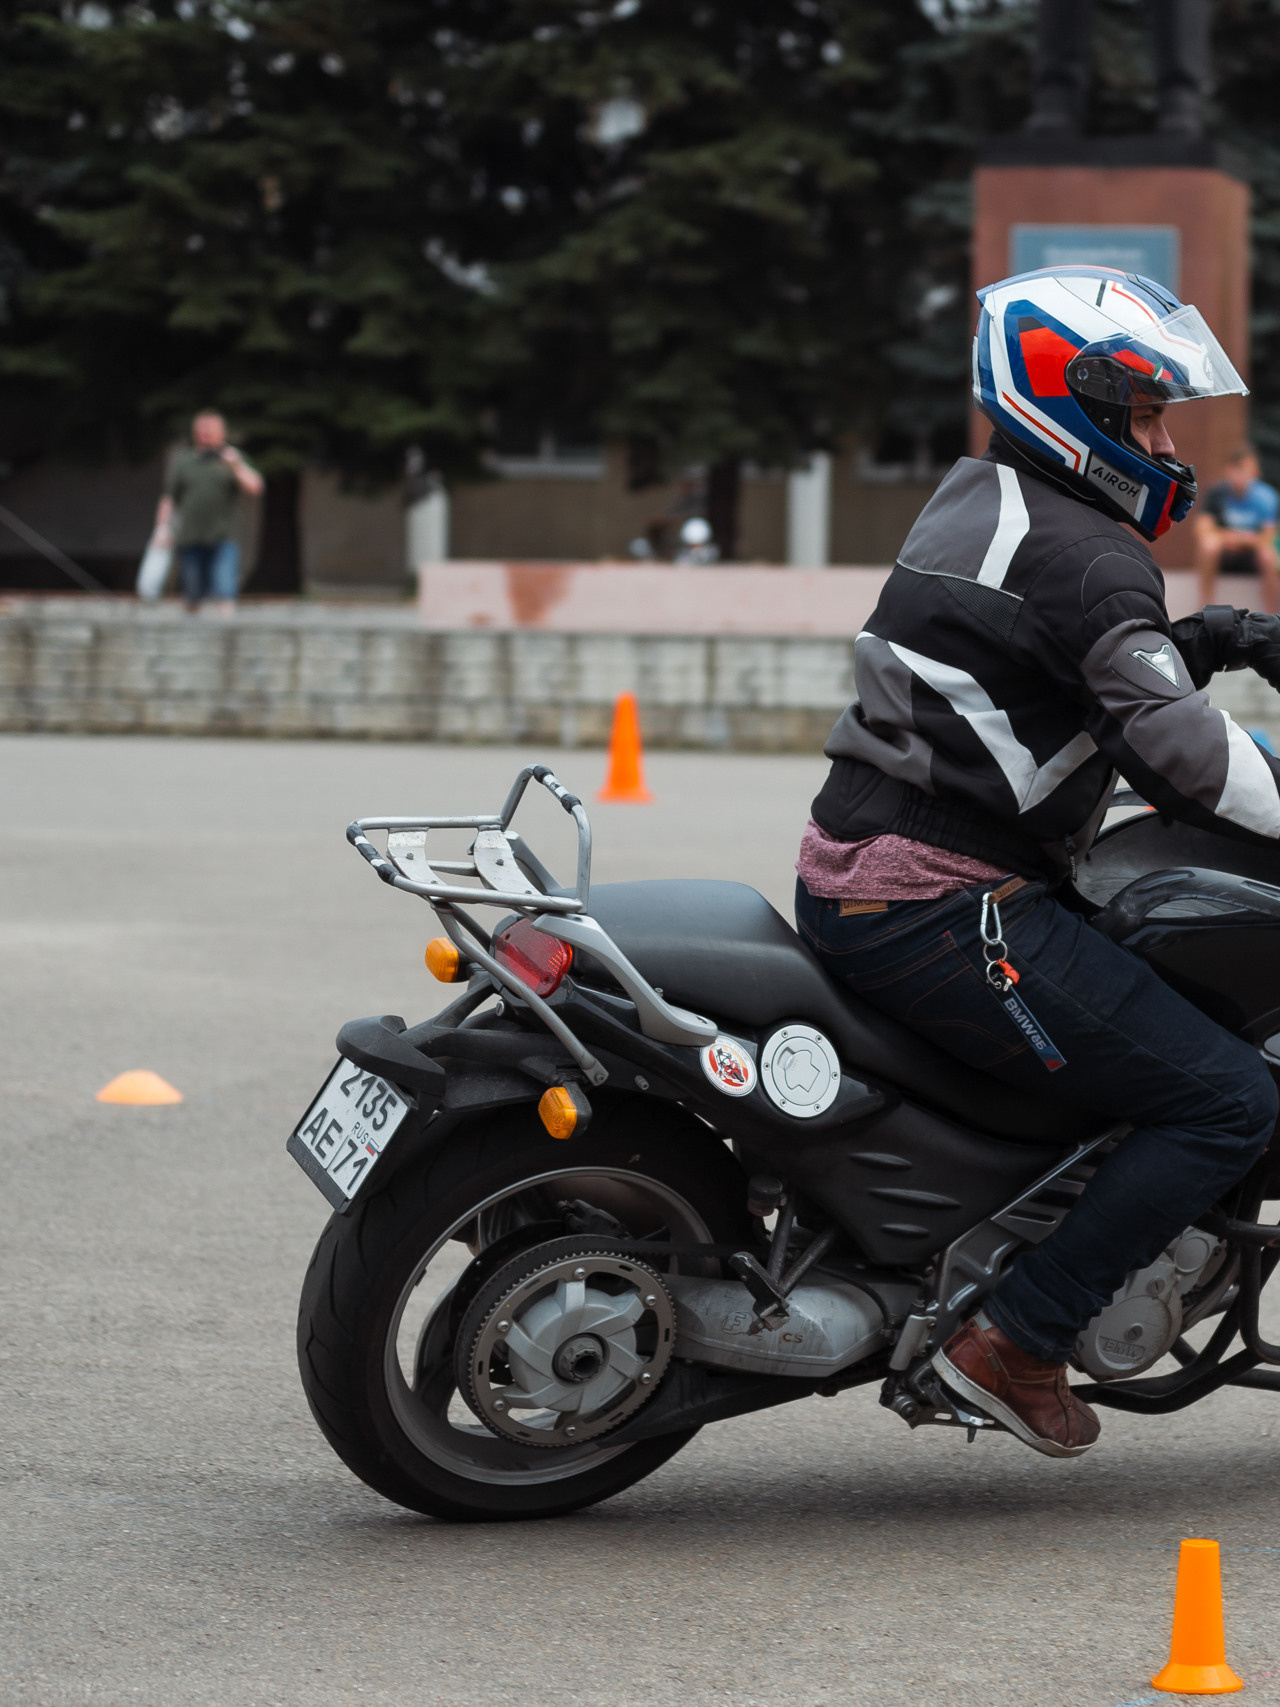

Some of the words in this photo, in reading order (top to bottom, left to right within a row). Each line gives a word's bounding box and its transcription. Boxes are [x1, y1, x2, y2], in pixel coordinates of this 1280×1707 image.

[1090, 465, 1141, 498] AIROH
[339, 1065, 398, 1131] 2135
[351, 1121, 370, 1145] RUS
[333, 1138, 368, 1191] 71
